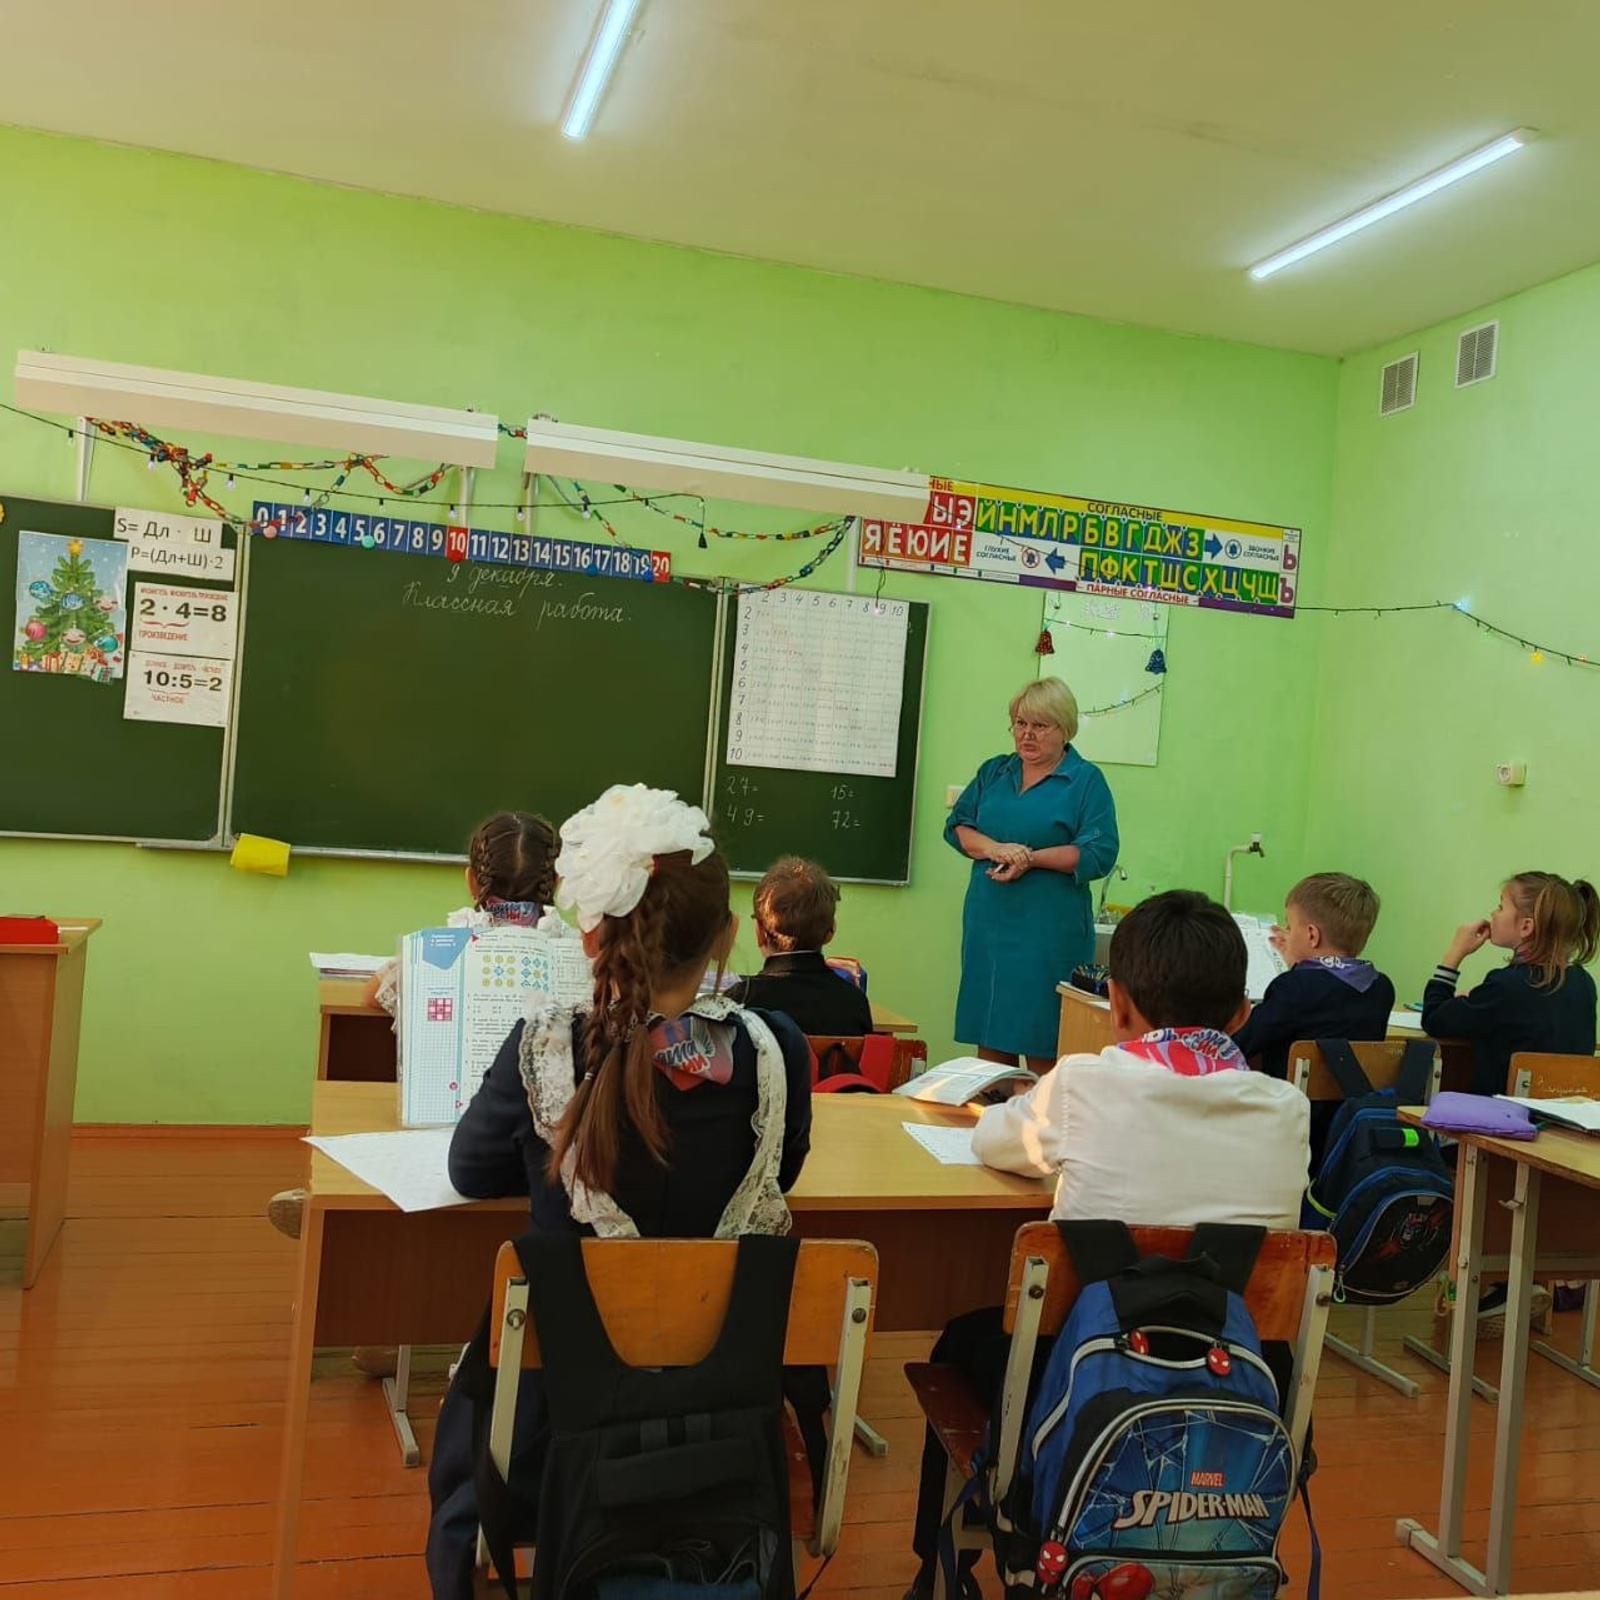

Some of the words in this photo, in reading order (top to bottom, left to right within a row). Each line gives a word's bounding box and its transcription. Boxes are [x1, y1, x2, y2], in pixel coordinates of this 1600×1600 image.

[1087, 502, 1163, 521] СОГЛАСНЫЕ
[117, 518, 139, 533] S=
[143, 521, 170, 540] Дл
[194, 526, 212, 543] Ш
[257, 507, 269, 527] 0
[315, 514, 327, 536] 3
[335, 517, 347, 539] 4
[354, 519, 366, 541] 5
[374, 522, 386, 544] 6
[393, 524, 406, 546] 7
[412, 527, 424, 549] 8
[432, 529, 444, 550] 9
[450, 531, 466, 552] 10
[470, 535, 486, 557] 11
[492, 537, 509, 559] 12
[513, 540, 529, 562] 13
[533, 542, 550, 564] 14
[554, 544, 570, 566] 15
[574, 546, 590, 568] 16
[594, 550, 611, 571] 17
[613, 552, 630, 574] 18
[633, 554, 650, 575] 19
[652, 556, 670, 576] 20
[976, 551, 1016, 561] СОГЛАСНЫЕ
[402, 580, 515, 617] Классная
[1087, 583, 1128, 598] ПАРНЫЕ
[1130, 588, 1189, 605] СОГЛАСНЫЕ
[140, 598, 155, 616] 2
[762, 591, 769, 603] 2
[780, 592, 787, 603] 3
[795, 595, 804, 605] 4
[812, 596, 820, 607] 5
[829, 597, 837, 608] 6
[847, 599, 853, 608] 7
[863, 601, 870, 613] 8
[879, 603, 886, 614] 9
[891, 605, 904, 617] 10
[743, 606, 752, 620] 2
[742, 624, 750, 636] 3
[741, 643, 749, 654] 4
[740, 659, 748, 671] 5
[143, 670, 222, 692] 10:5=2
[738, 676, 746, 688] 6
[738, 694, 746, 705] 7
[735, 712, 742, 726] 8
[736, 730, 743, 742] 9
[729, 748, 743, 760] 10
[1190, 1472, 1224, 1488] MARVEL
[1113, 1490, 1270, 1529] SPIDER-MAN
